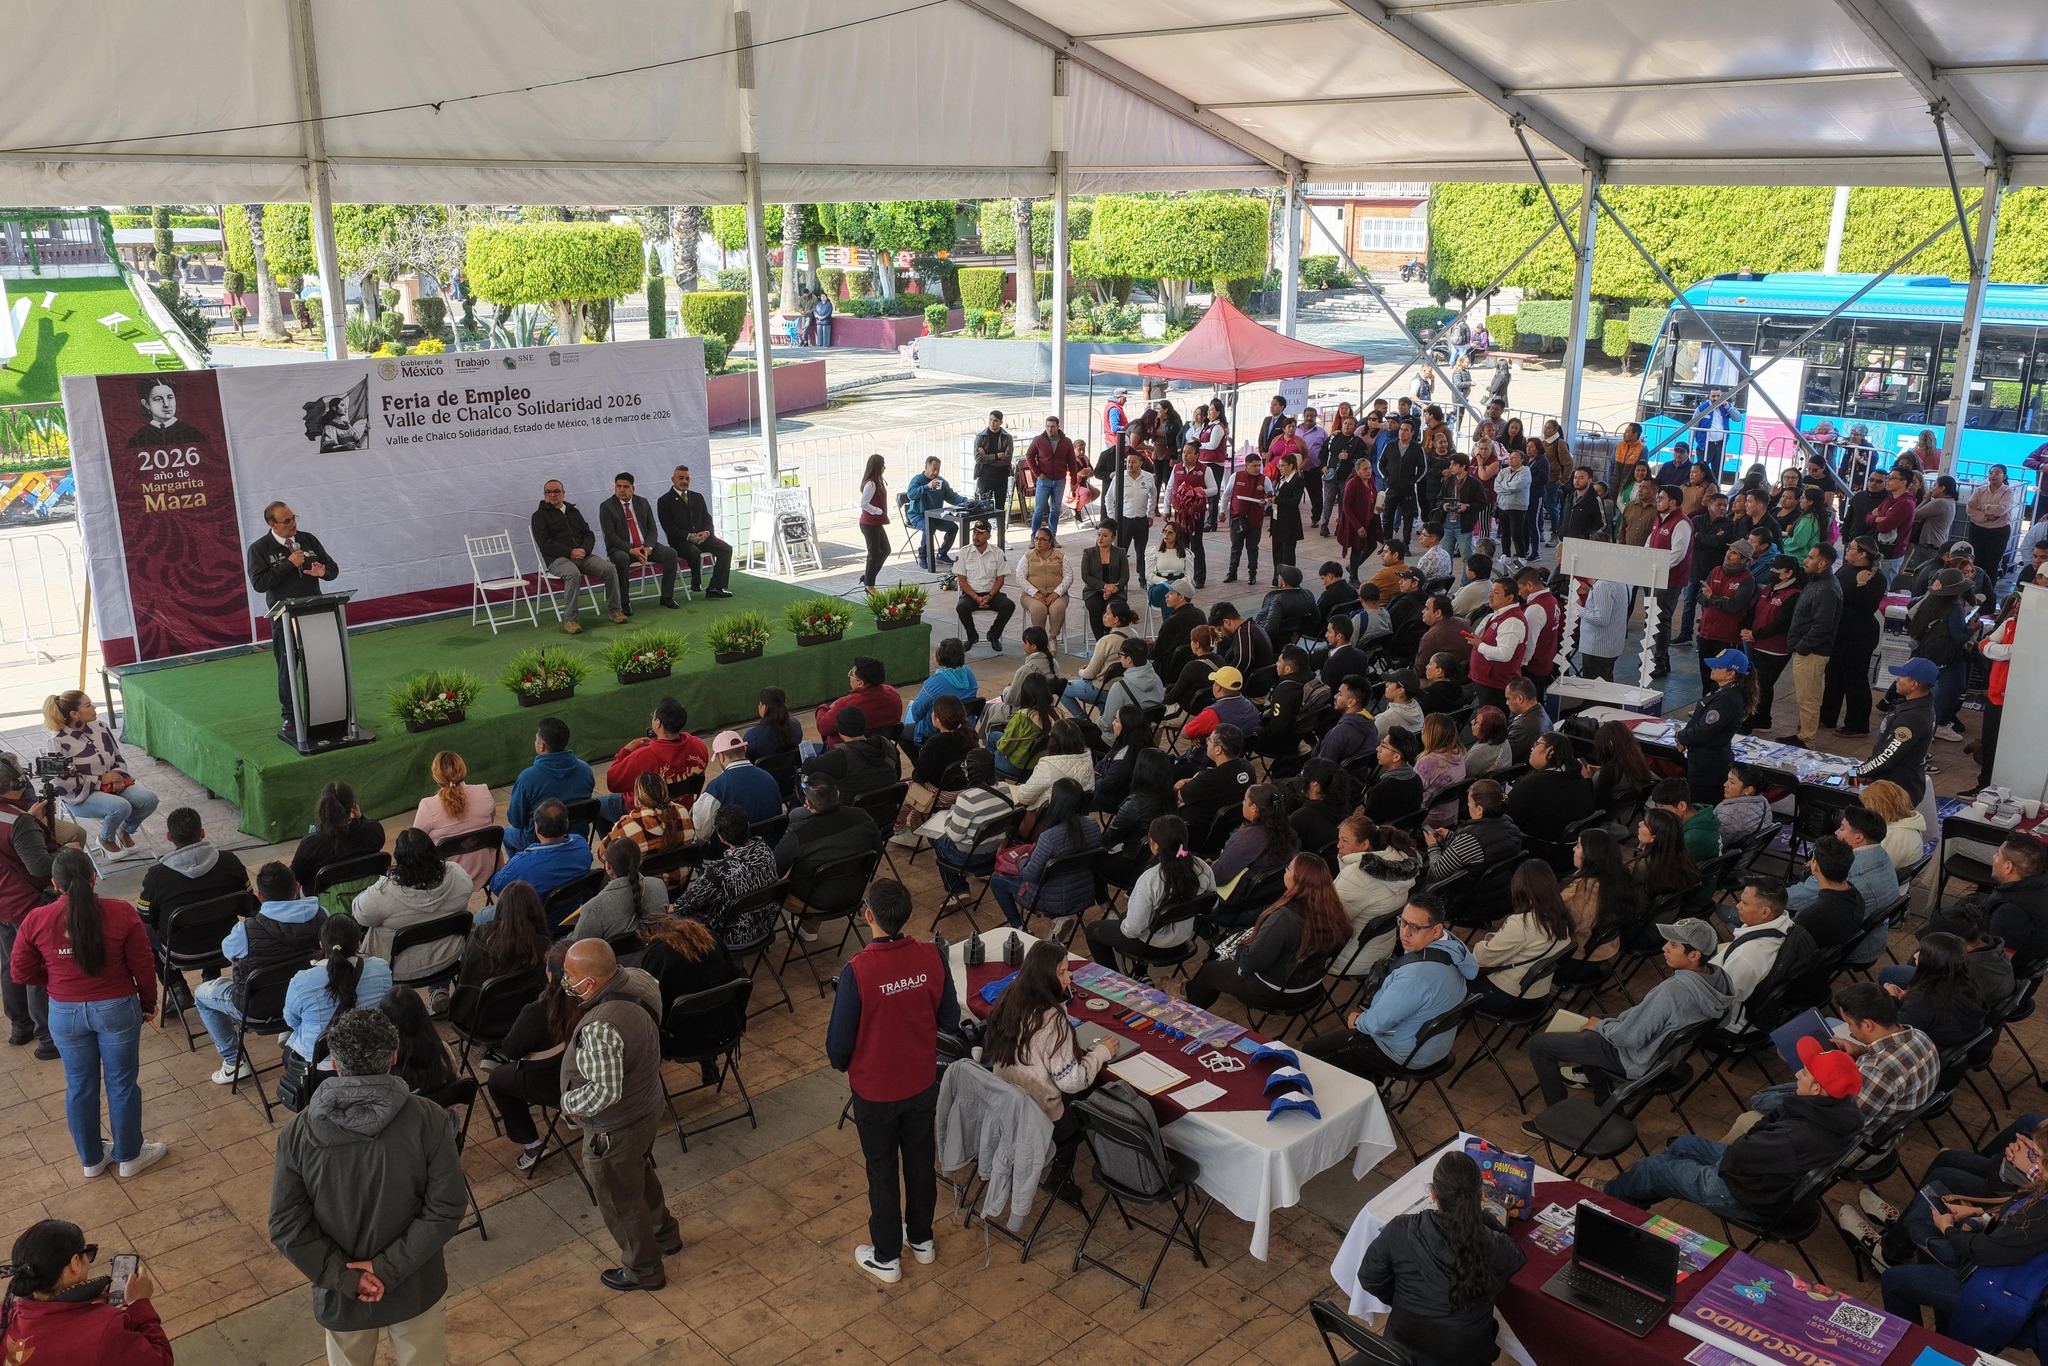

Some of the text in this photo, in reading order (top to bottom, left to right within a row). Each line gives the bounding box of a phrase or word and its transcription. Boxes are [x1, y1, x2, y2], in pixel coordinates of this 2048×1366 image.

[400, 359, 433, 367] Gobierno
[455, 357, 490, 367] Trabajo
[518, 354, 535, 362] SNE
[402, 365, 444, 378] México
[381, 385, 531, 411] Feria de Empleo
[383, 393, 642, 428] Valle de Chalco Solidaridad 2026
[386, 410, 671, 445] Valle de Chalco Solidaridad, Estado de México, 18 de marzo de 2026
[138, 447, 200, 471] 2026
[154, 469, 190, 480] año de
[141, 478, 204, 493] Margarita
[143, 492, 207, 513] Maza
[1273, 702, 1281, 716] S
[879, 973, 927, 994] TRABAJO
